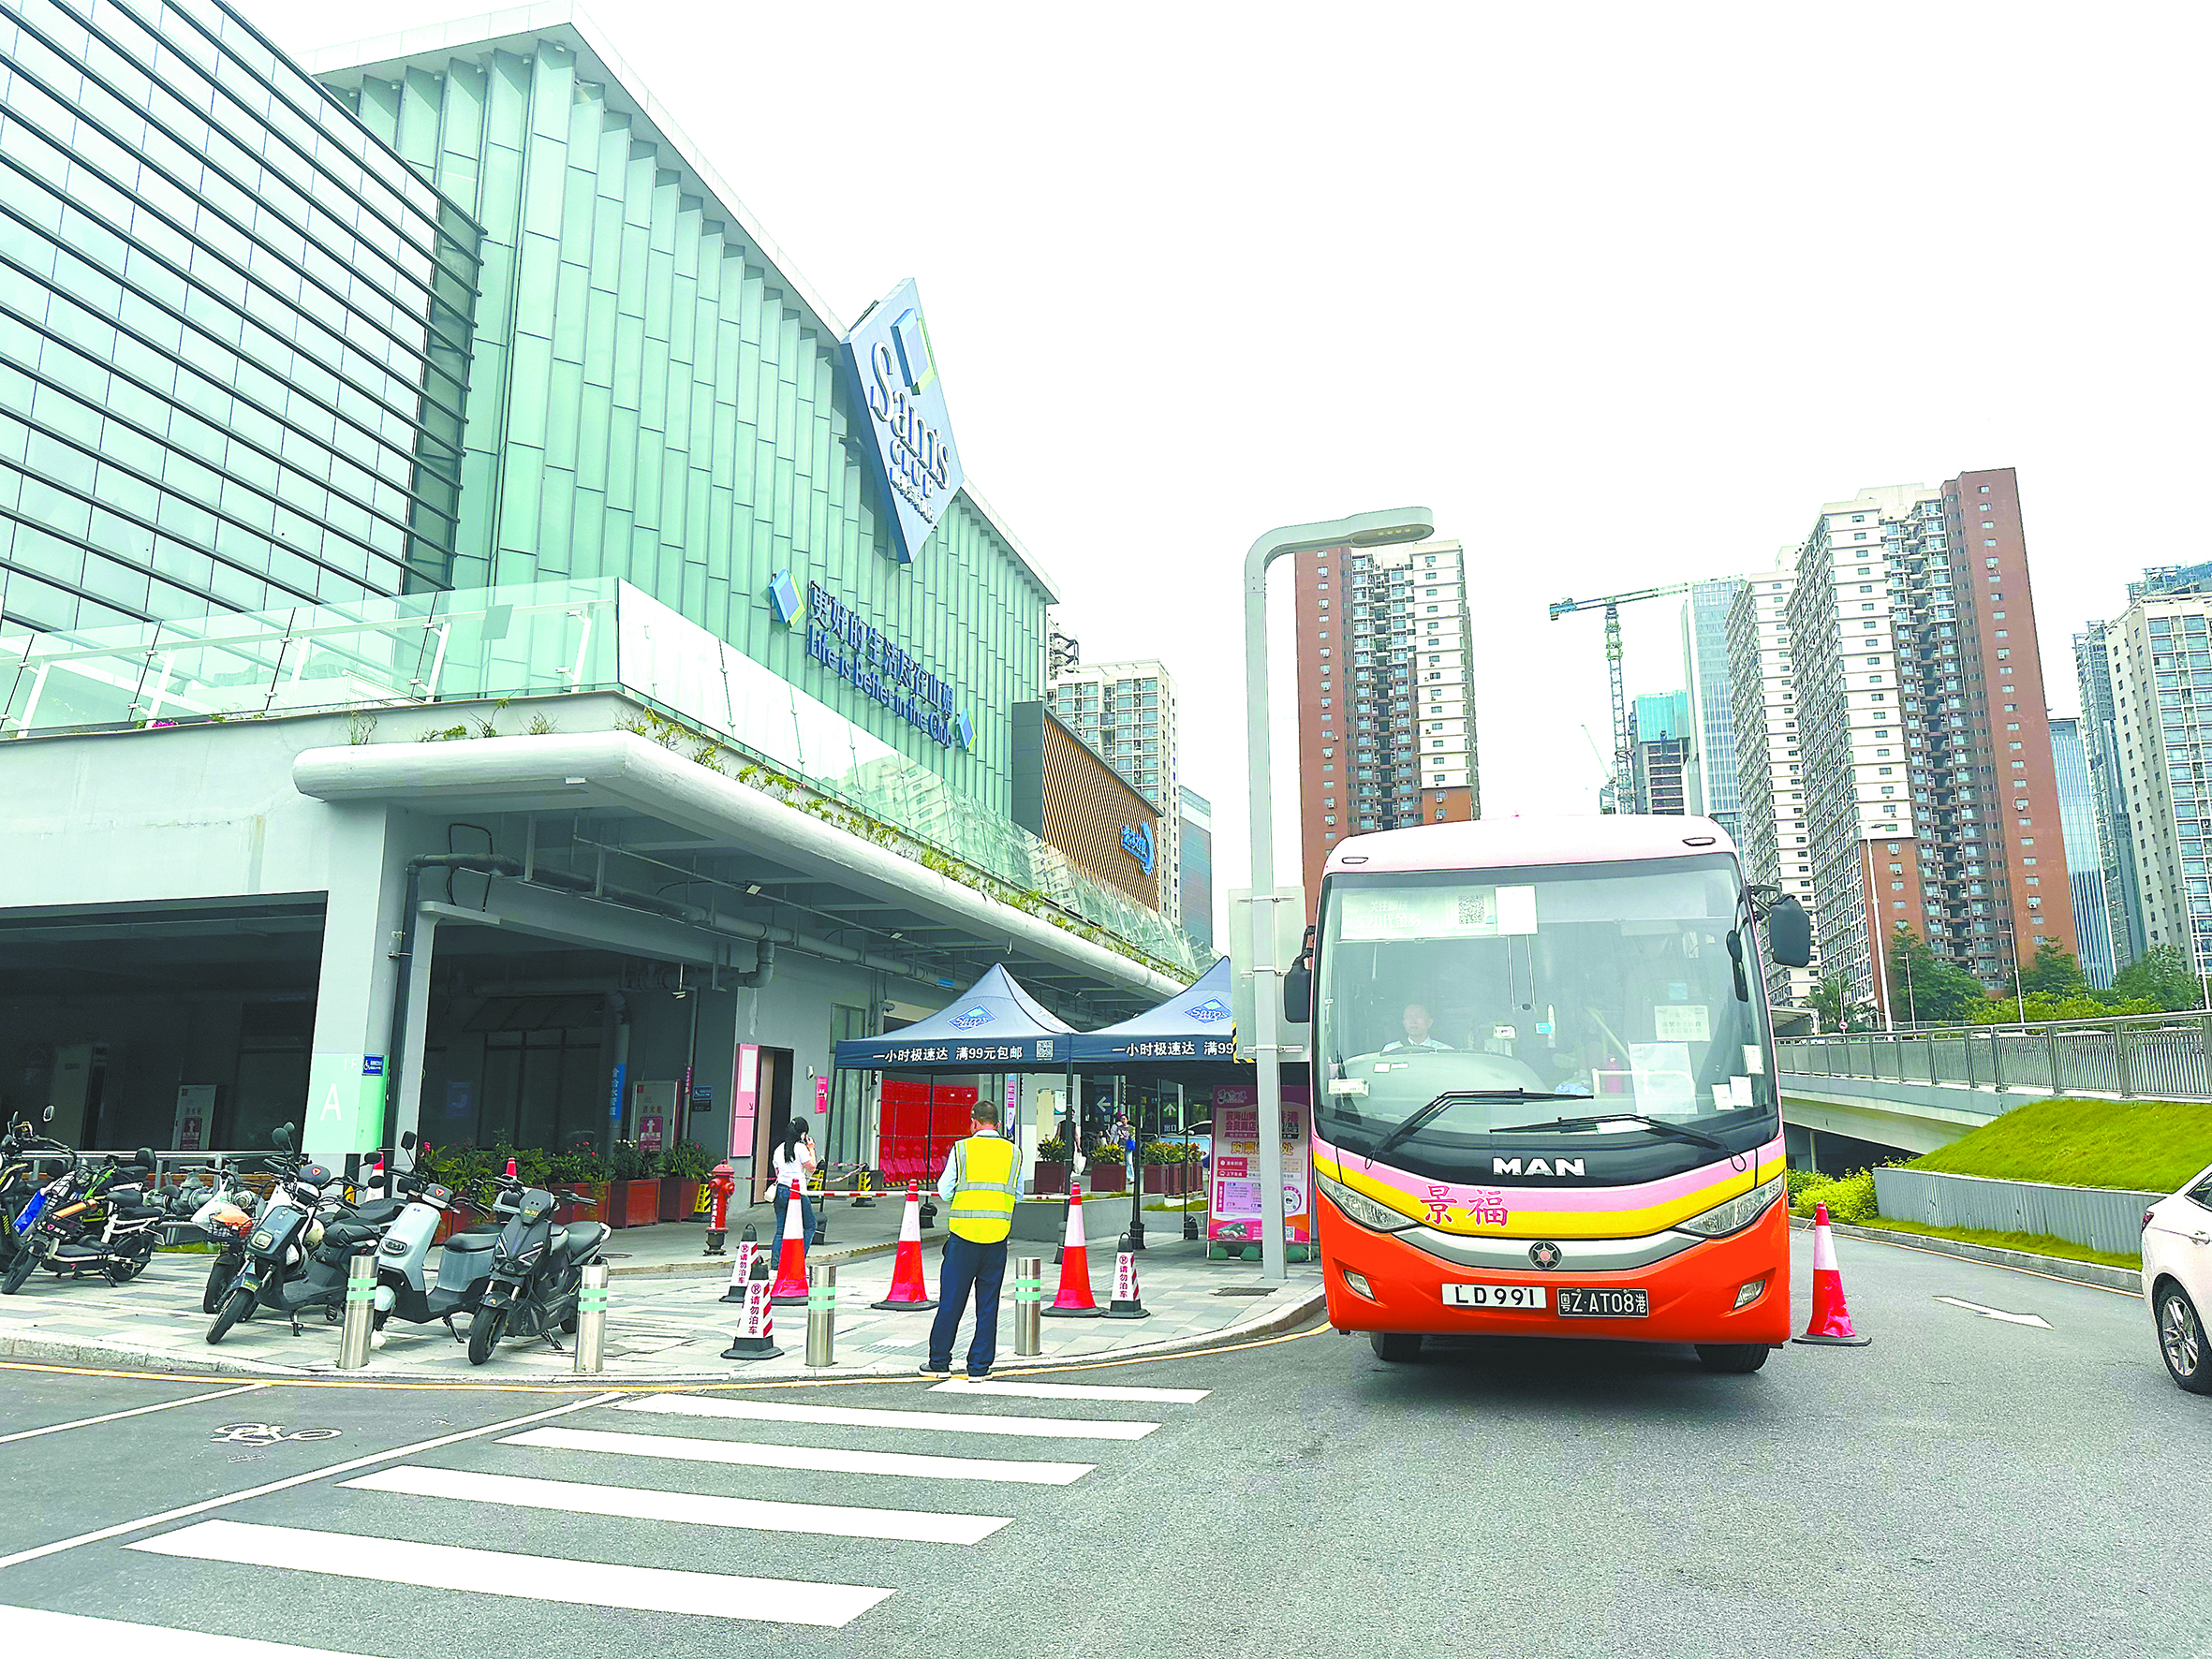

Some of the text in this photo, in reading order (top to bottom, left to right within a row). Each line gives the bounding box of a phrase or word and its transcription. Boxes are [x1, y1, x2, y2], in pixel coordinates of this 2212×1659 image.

[870, 341, 951, 491] Sam's
[808, 624, 837, 668] Life
[853, 653, 894, 707] Better
[894, 686, 905, 717] in
[907, 697, 927, 730] the
[928, 712, 952, 749] Club
[1369, 900, 1408, 913] 关注即送
[873, 1046, 1023, 1063] 一小时极速达 满99元包邮
[1112, 1040, 1196, 1057] 一小时极速达
[319, 1083, 342, 1122] A
[1493, 1157, 1585, 1177] MAN
[1420, 1185, 1509, 1226] 景福
[1119, 1265, 1128, 1299] 请勿泊车
[1454, 1285, 1534, 1306] LD 991
[748, 1296, 759, 1334] 请勿泊车
